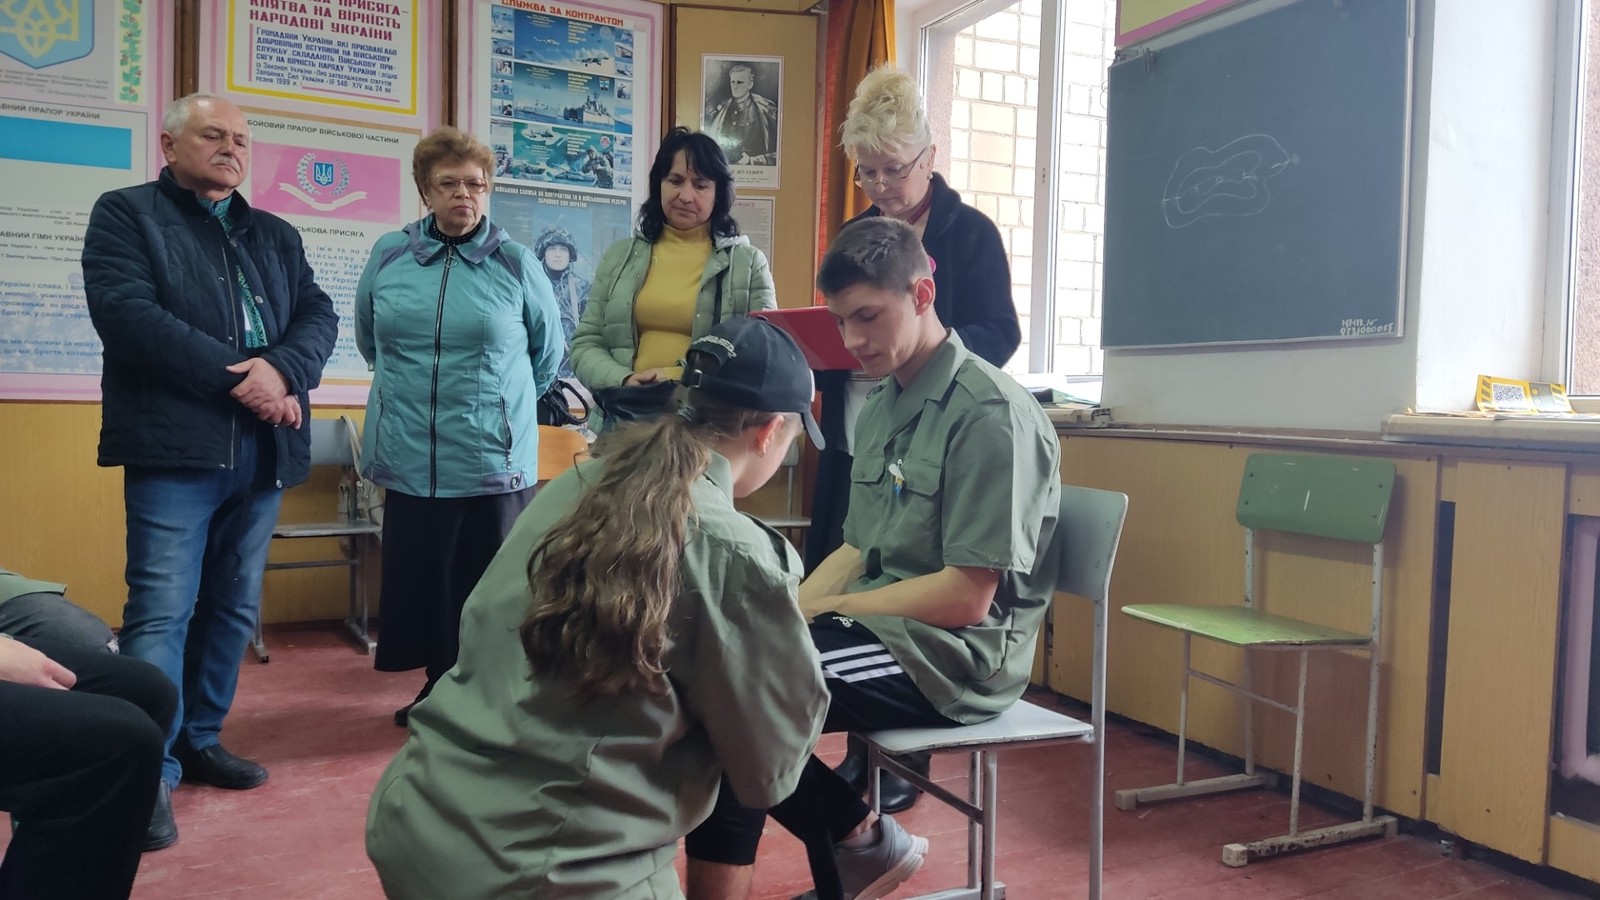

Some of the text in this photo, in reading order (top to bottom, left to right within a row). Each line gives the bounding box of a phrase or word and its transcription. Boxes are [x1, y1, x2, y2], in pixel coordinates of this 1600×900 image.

[250, 0, 401, 30] КЛЯТВА НА ВІРНІСТЬ
[501, 0, 546, 12] СЛУЖБА
[550, 6, 562, 15] ЗА
[565, 9, 624, 27] КОНТРАКТОМ
[250, 9, 392, 41] НАРОДОВІ УКРАЇНИ
[256, 37, 391, 63] ДОБРОВІЛЬНО ВСТУПИЛИ НА ВІЙСЬКОВУ
[384, 47, 397, 56] АБО
[292, 50, 335, 63] СКЛАДАЮТЬ
[256, 53, 273, 62] СЯГУ
[276, 55, 285, 63] НА
[318, 62, 344, 72] НАРОДУ
[348, 65, 377, 76] УКРАЇНИ
[276, 77, 291, 86] 1999
[0, 103, 100, 120] ВНИЙ ПРАПОР УКРАЇНИ
[247, 118, 400, 145] БОЙОВИЙ ПРАПОР ВІЙСЬКОВОЇ ЧАСТИНИ
[54, 235, 85, 243] УКРАЇН
[329, 229, 365, 238] ПРИСЯГА
[307, 253, 354, 262] військову
[332, 276, 357, 284] Україн
[321, 284, 357, 292] торіальн
[328, 291, 356, 299] сумлін
